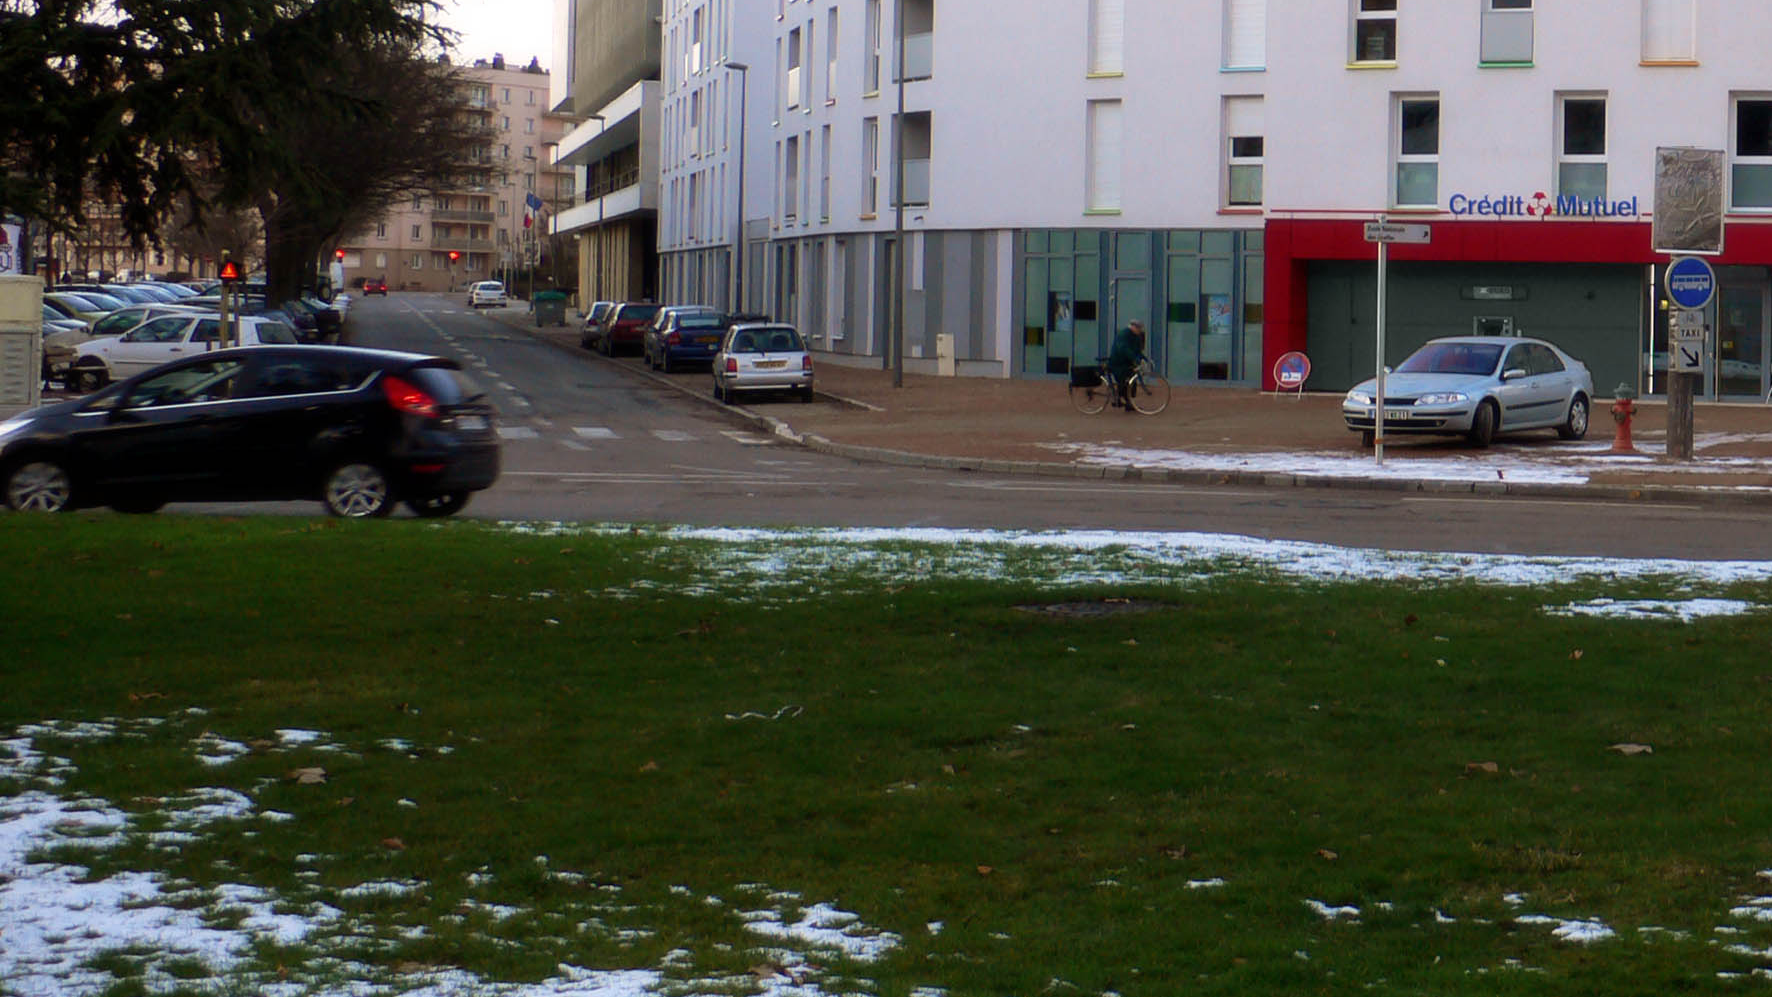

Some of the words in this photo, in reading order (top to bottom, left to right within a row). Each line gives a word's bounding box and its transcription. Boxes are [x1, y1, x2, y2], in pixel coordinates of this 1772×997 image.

[1450, 193, 1524, 216] Crédit
[1556, 194, 1638, 217] Mutuel
[1681, 329, 1700, 338] TAXI
